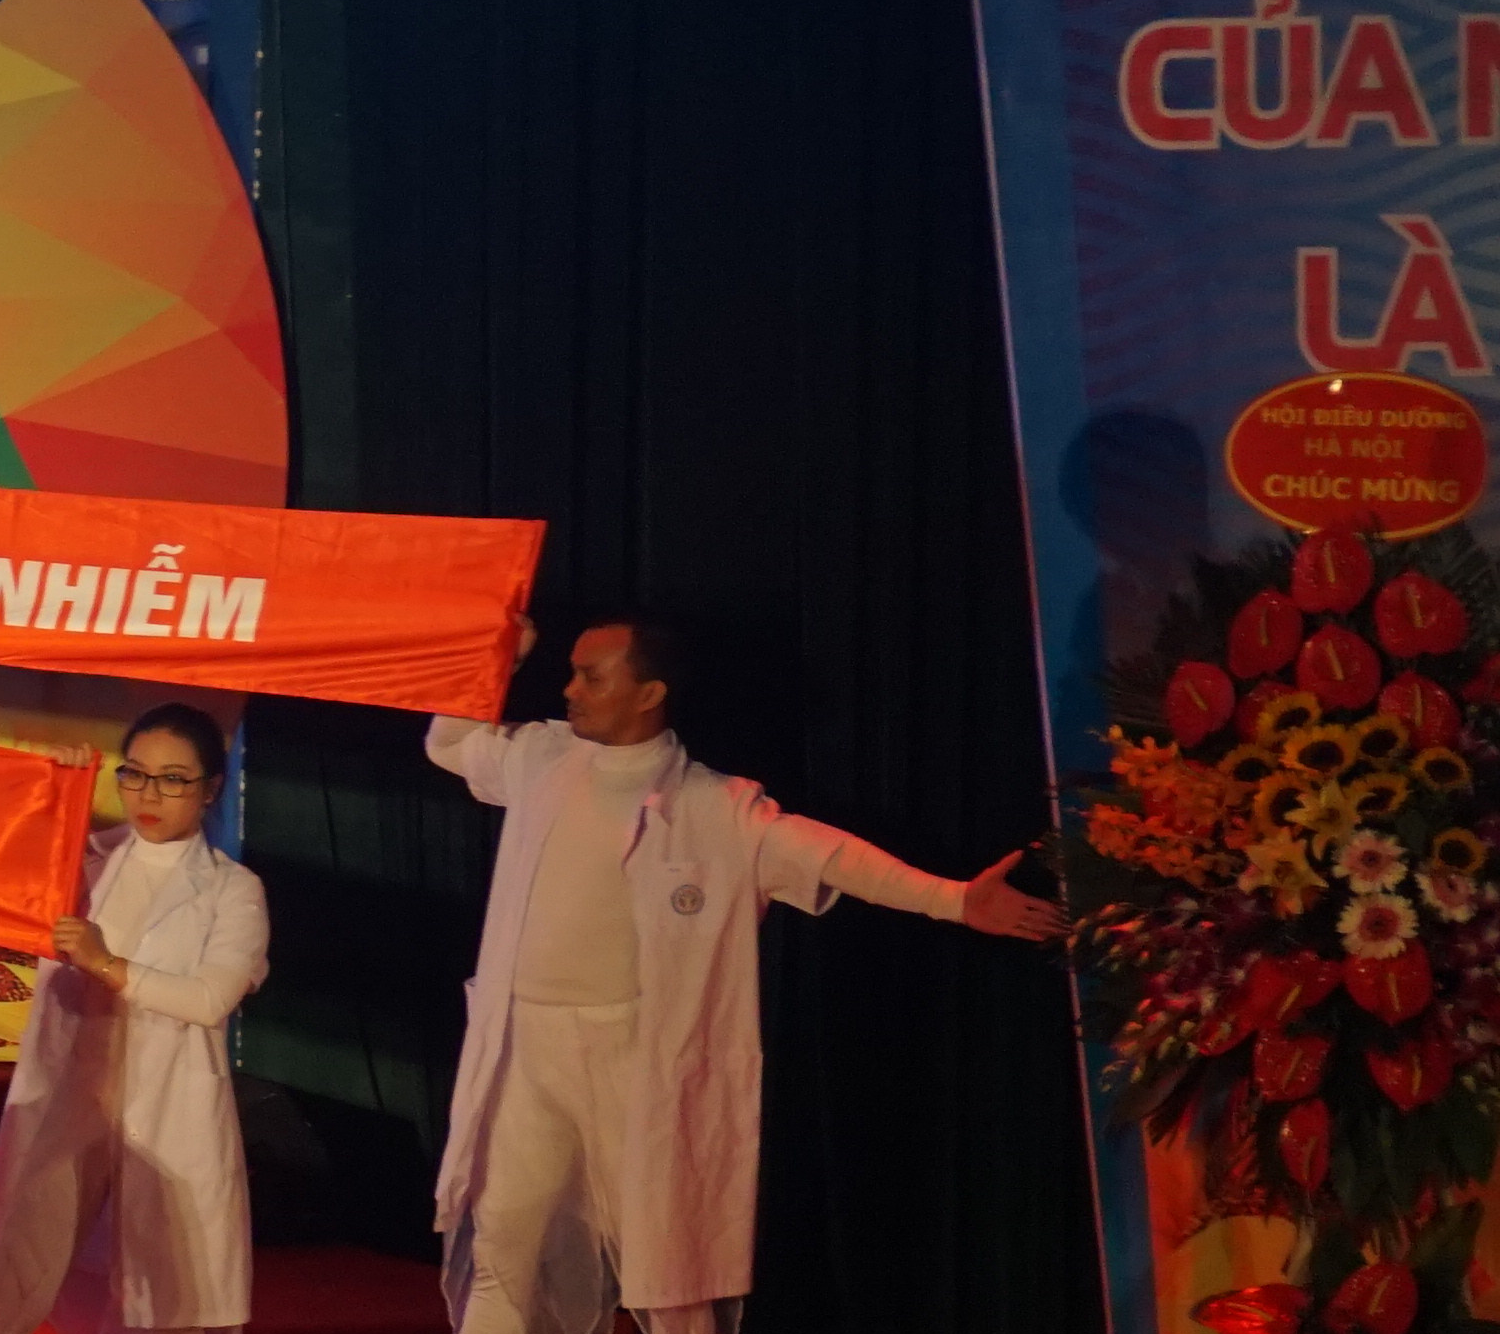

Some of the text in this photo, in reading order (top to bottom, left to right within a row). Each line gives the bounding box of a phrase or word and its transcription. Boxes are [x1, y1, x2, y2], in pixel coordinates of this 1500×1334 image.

[1296, 214, 1493, 377] LÀ
[1350, 433, 1405, 462] NỘI
[1262, 470, 1461, 503] CHÚC MỪNG
